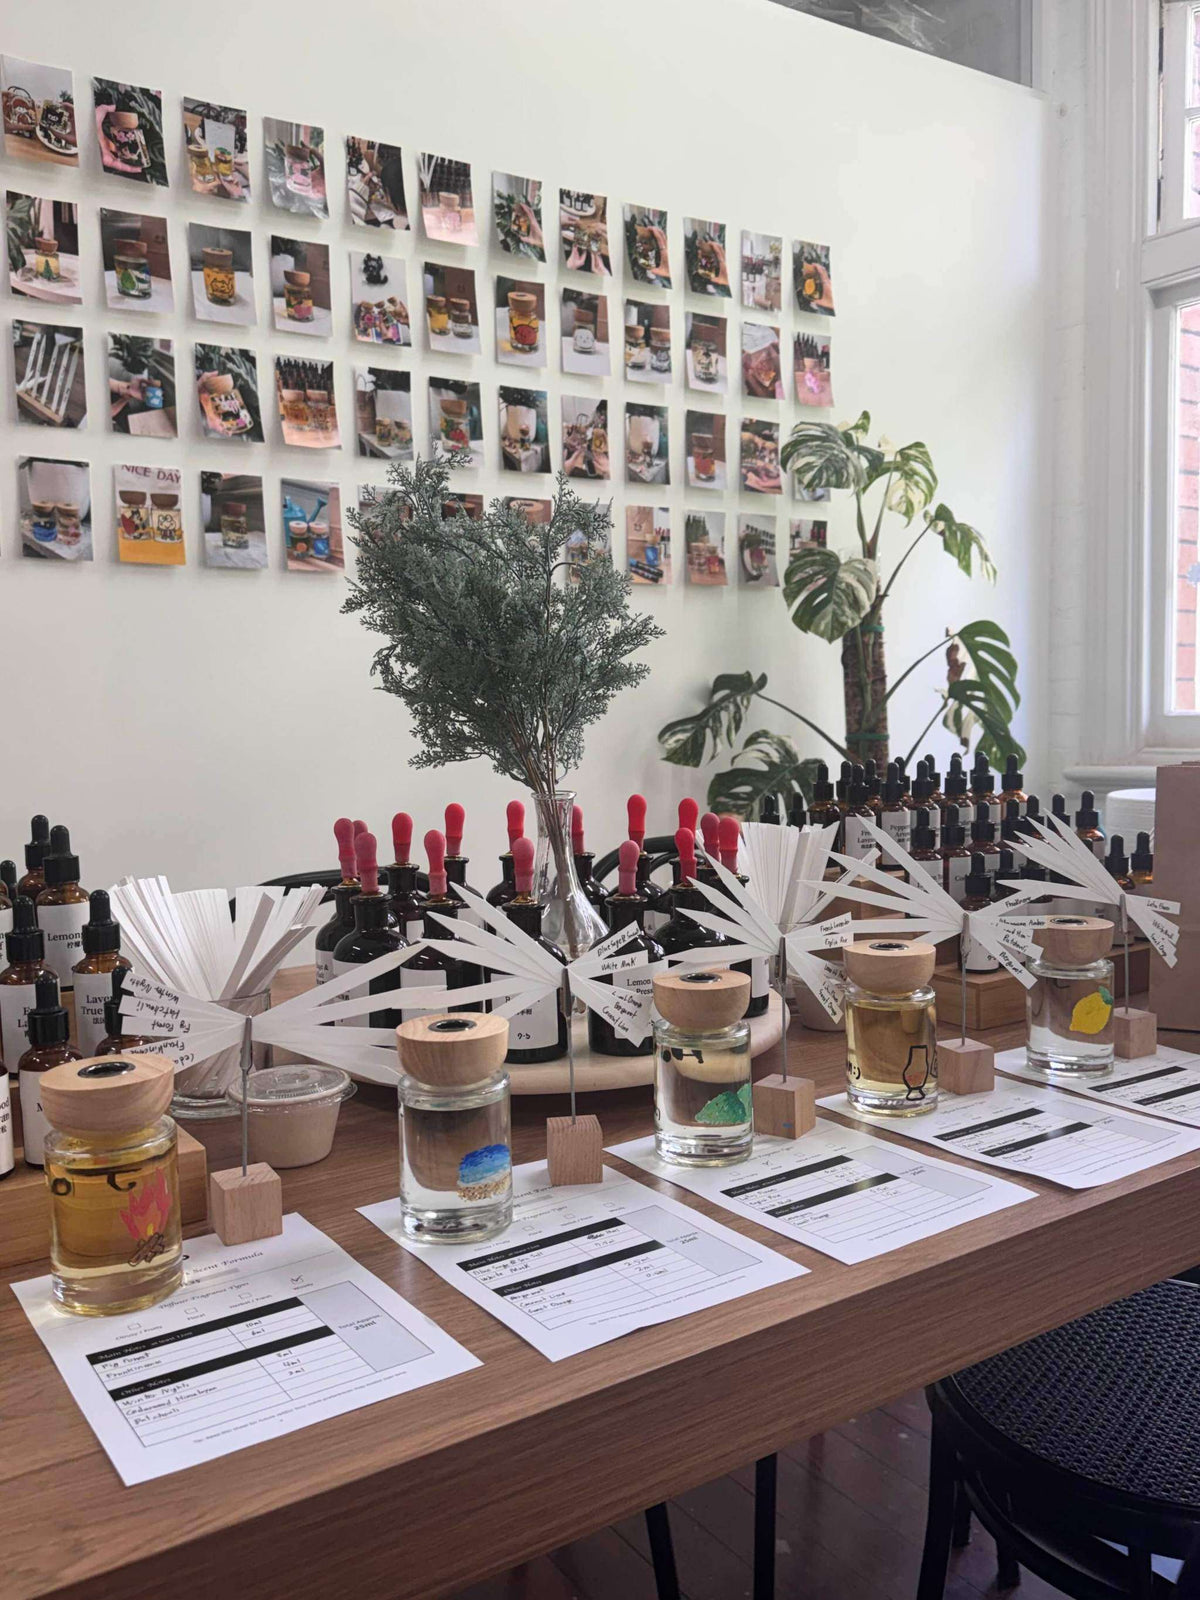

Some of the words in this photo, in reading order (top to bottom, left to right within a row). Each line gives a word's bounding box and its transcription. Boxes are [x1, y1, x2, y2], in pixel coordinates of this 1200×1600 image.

[121, 464, 151, 478] NICE
[156, 469, 181, 484] DAY
[81, 1006, 103, 1015] True
[221, 1250, 264, 1267] Formula
[354, 1320, 377, 1331] 25ml
[98, 1351, 122, 1362] Main
[123, 1343, 147, 1353] Notes
[120, 1386, 144, 1397] Other
[147, 1378, 172, 1388] Notes
